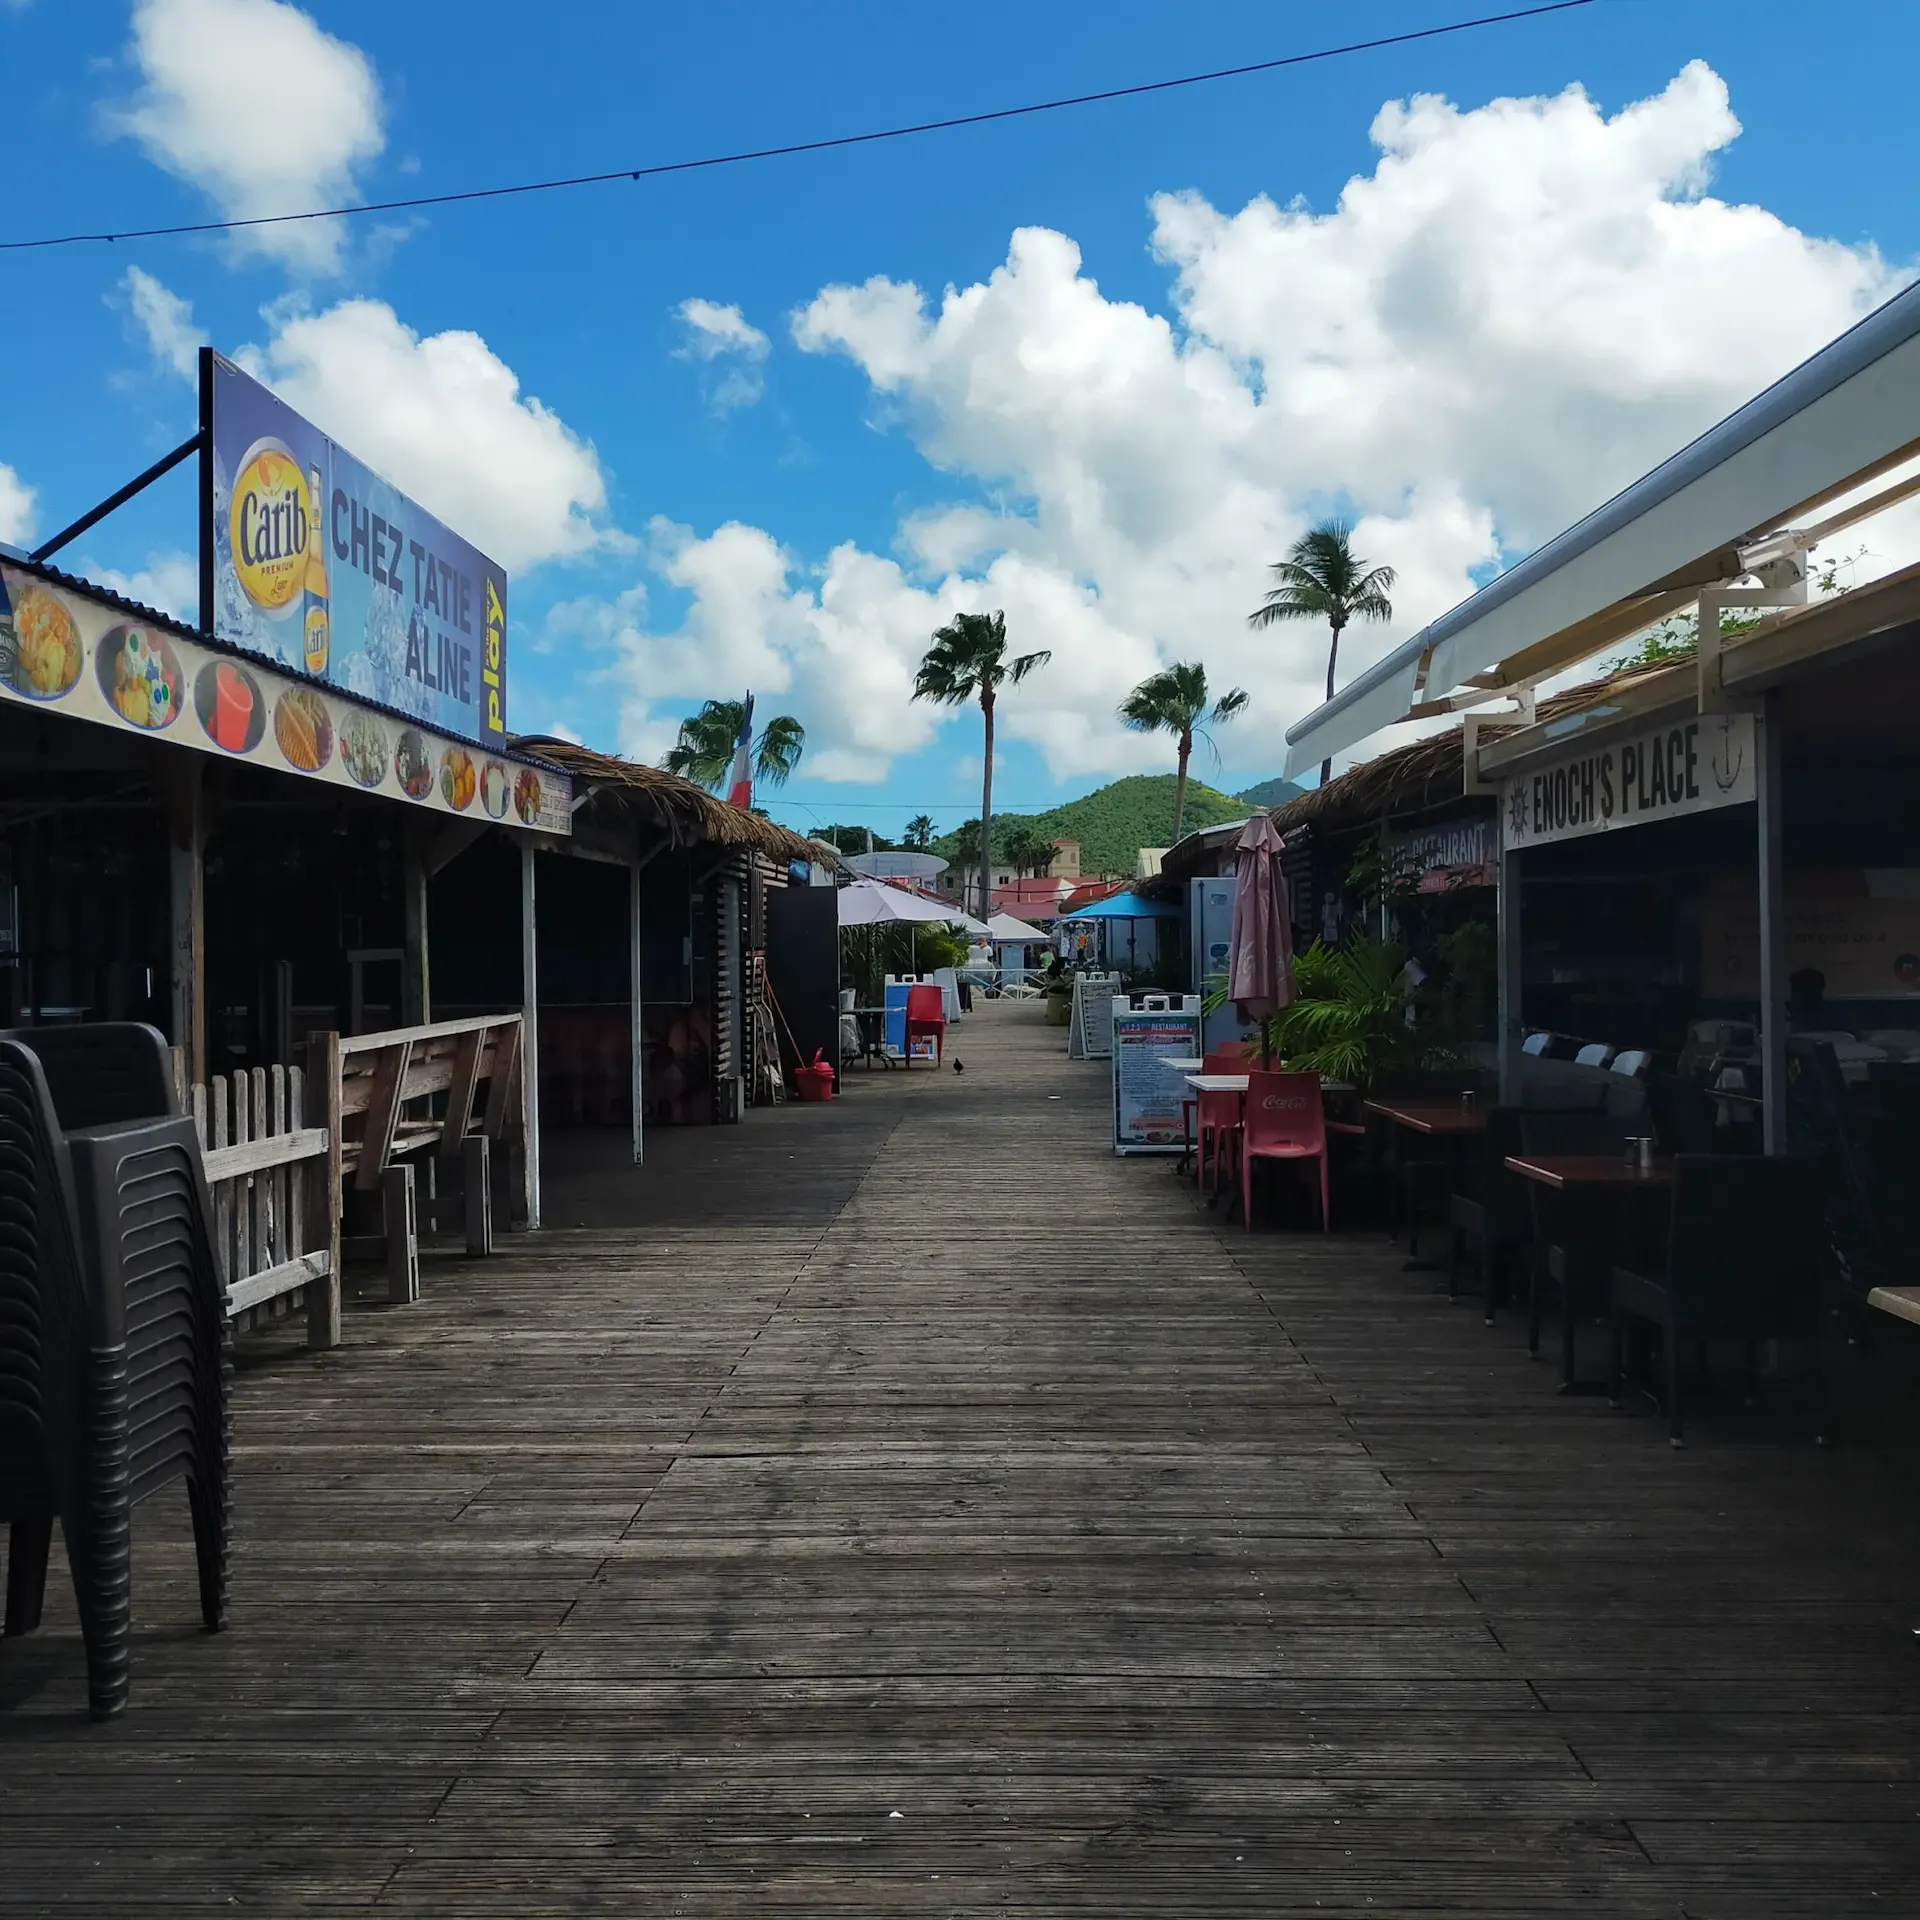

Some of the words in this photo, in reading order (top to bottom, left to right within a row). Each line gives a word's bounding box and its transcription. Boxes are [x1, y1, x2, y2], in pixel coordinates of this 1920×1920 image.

[240, 484, 307, 567] Carib
[260, 561, 294, 577] PREMIUM
[332, 488, 403, 595] CHEZ
[410, 539, 471, 635] TATIE
[405, 617, 471, 705] ALINE
[484, 579, 504, 734] play
[1533, 752, 1614, 834] ENOCH'S
[1622, 723, 1699, 814] PLACE
